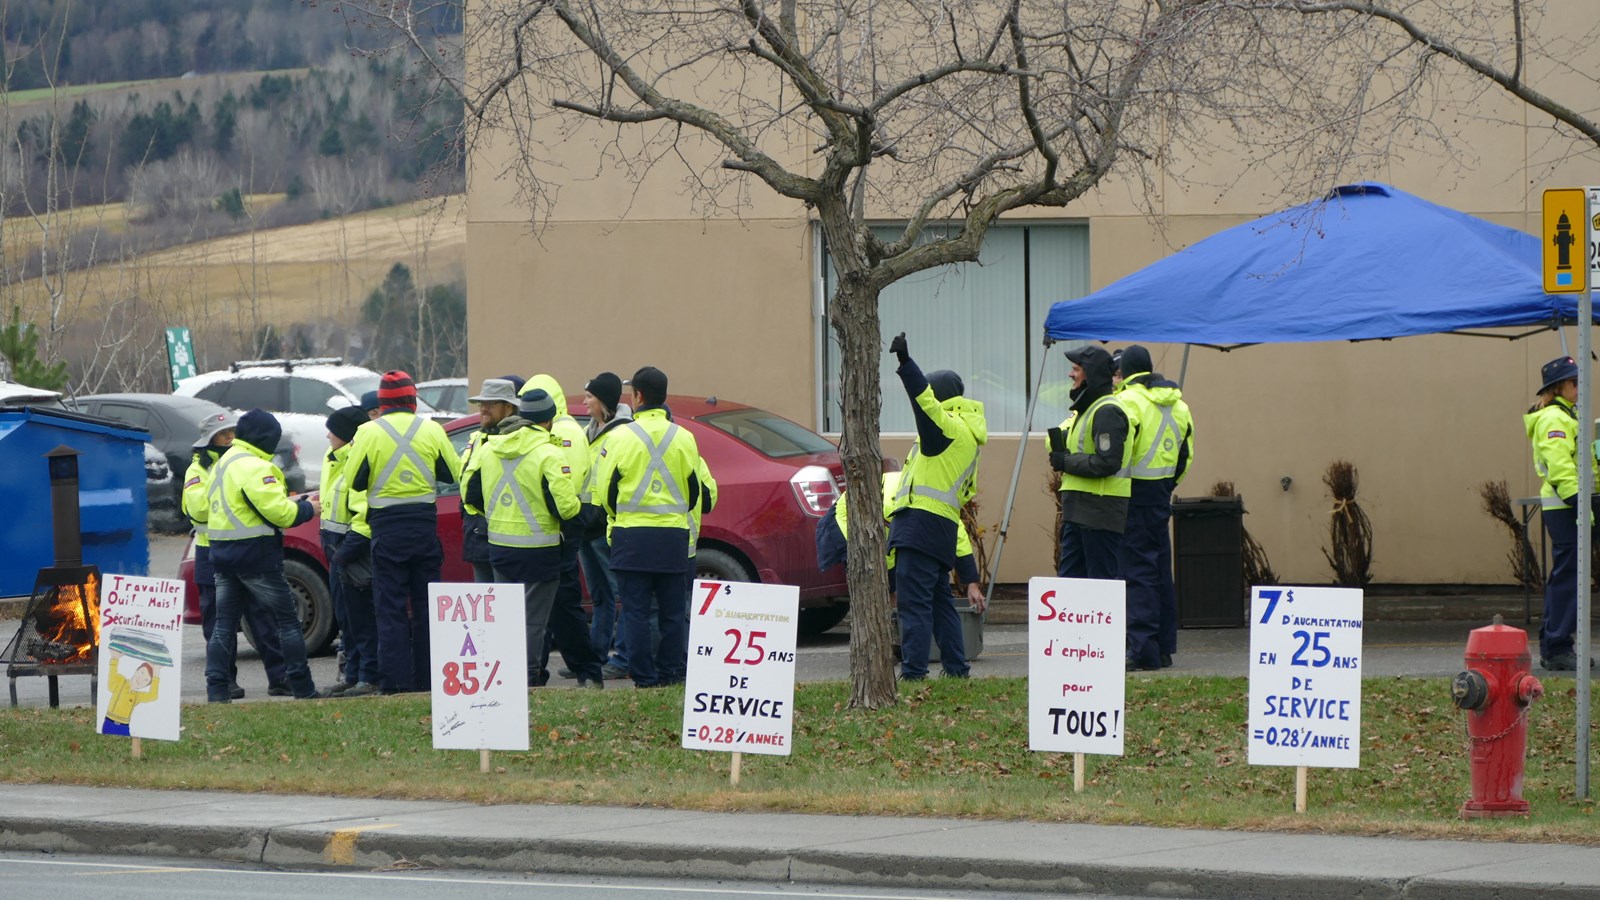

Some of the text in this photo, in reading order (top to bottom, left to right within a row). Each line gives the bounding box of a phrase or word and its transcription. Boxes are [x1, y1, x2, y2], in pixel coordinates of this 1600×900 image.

[113, 576, 180, 594] Travailler
[436, 586, 496, 623] PAYÉ
[715, 608, 790, 623] D'AUGMENTATION
[1037, 589, 1113, 625] Sécurité
[102, 608, 181, 631] Sécuritairement!
[1281, 614, 1363, 629] D'AUGMENTATION
[459, 623, 478, 657] À
[697, 628, 794, 666] EN 25 ANS
[1043, 639, 1106, 662] d'emplois
[1259, 630, 1358, 670] EN 25 ANS
[442, 660, 502, 696] 85%
[729, 675, 749, 689] DE
[1062, 683, 1093, 697] pour
[1291, 676, 1313, 691] DE
[693, 692, 783, 719] SERVICE
[1263, 695, 1350, 721] SERVICE
[1048, 707, 1120, 739] TOUS!
